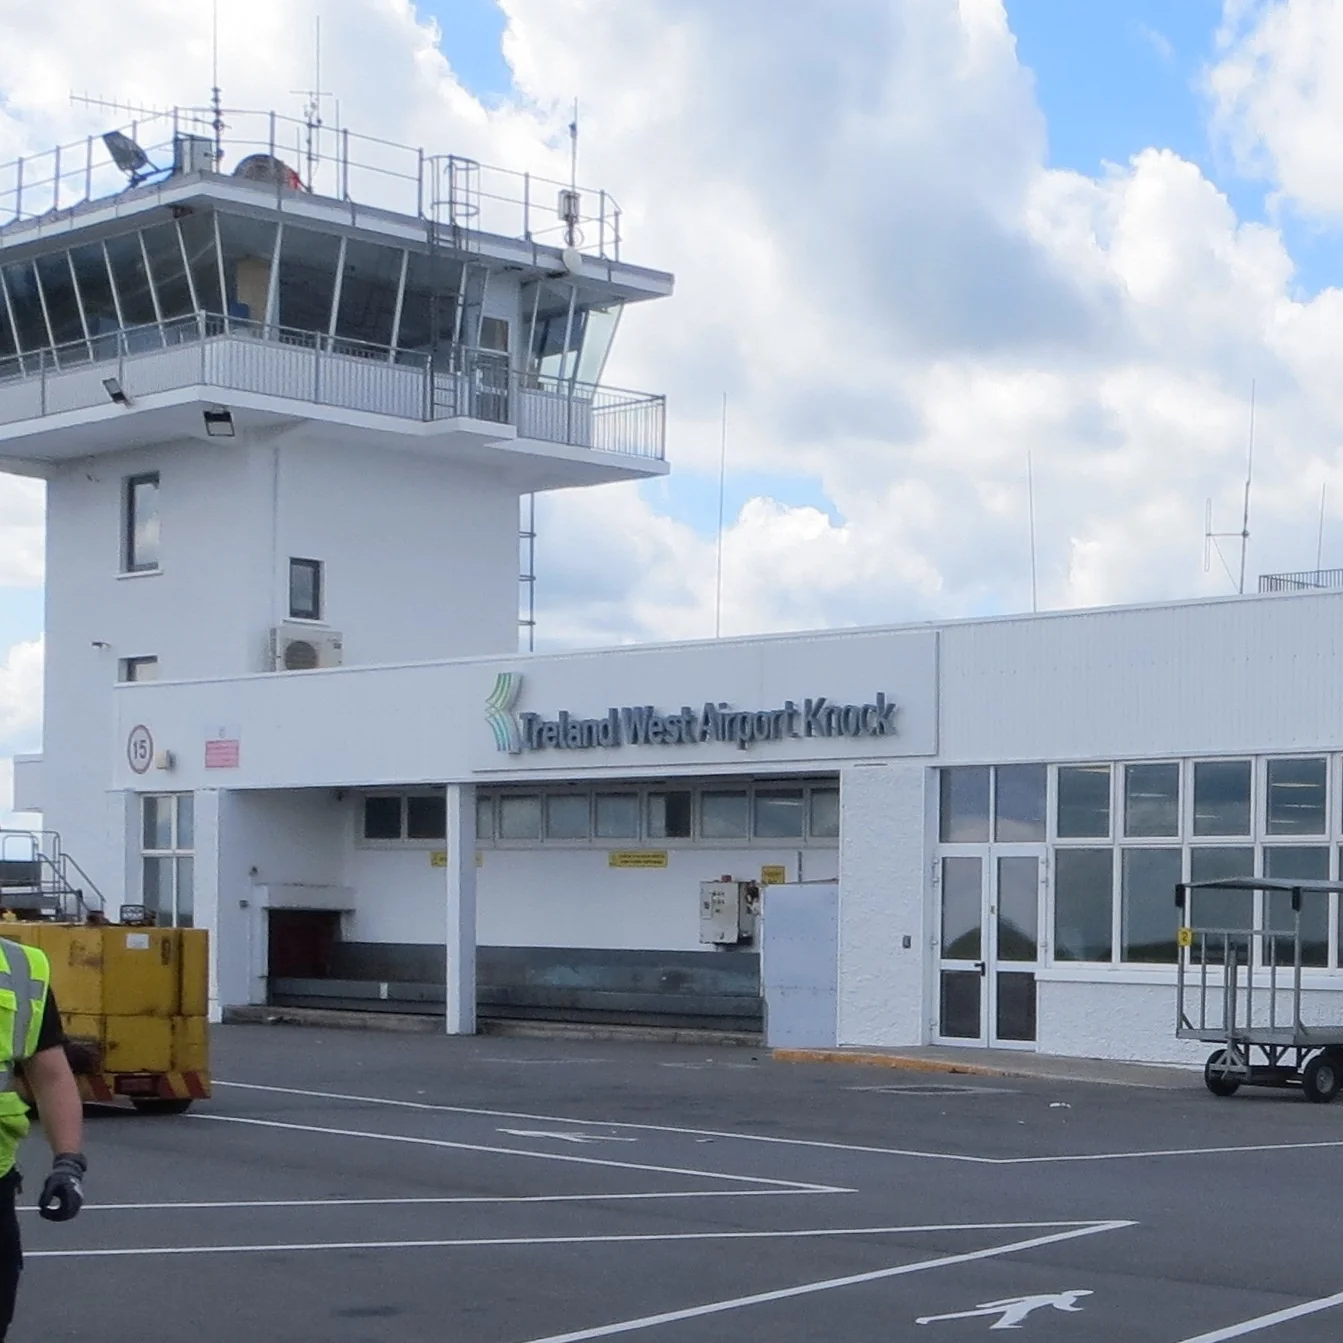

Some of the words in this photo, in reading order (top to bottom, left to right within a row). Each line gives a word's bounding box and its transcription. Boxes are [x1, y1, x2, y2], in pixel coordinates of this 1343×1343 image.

[519, 710, 619, 750] Ireland
[620, 705, 699, 746] West
[699, 702, 801, 750] Airport
[803, 692, 898, 738] Knock
[132, 739, 147, 760] 15
